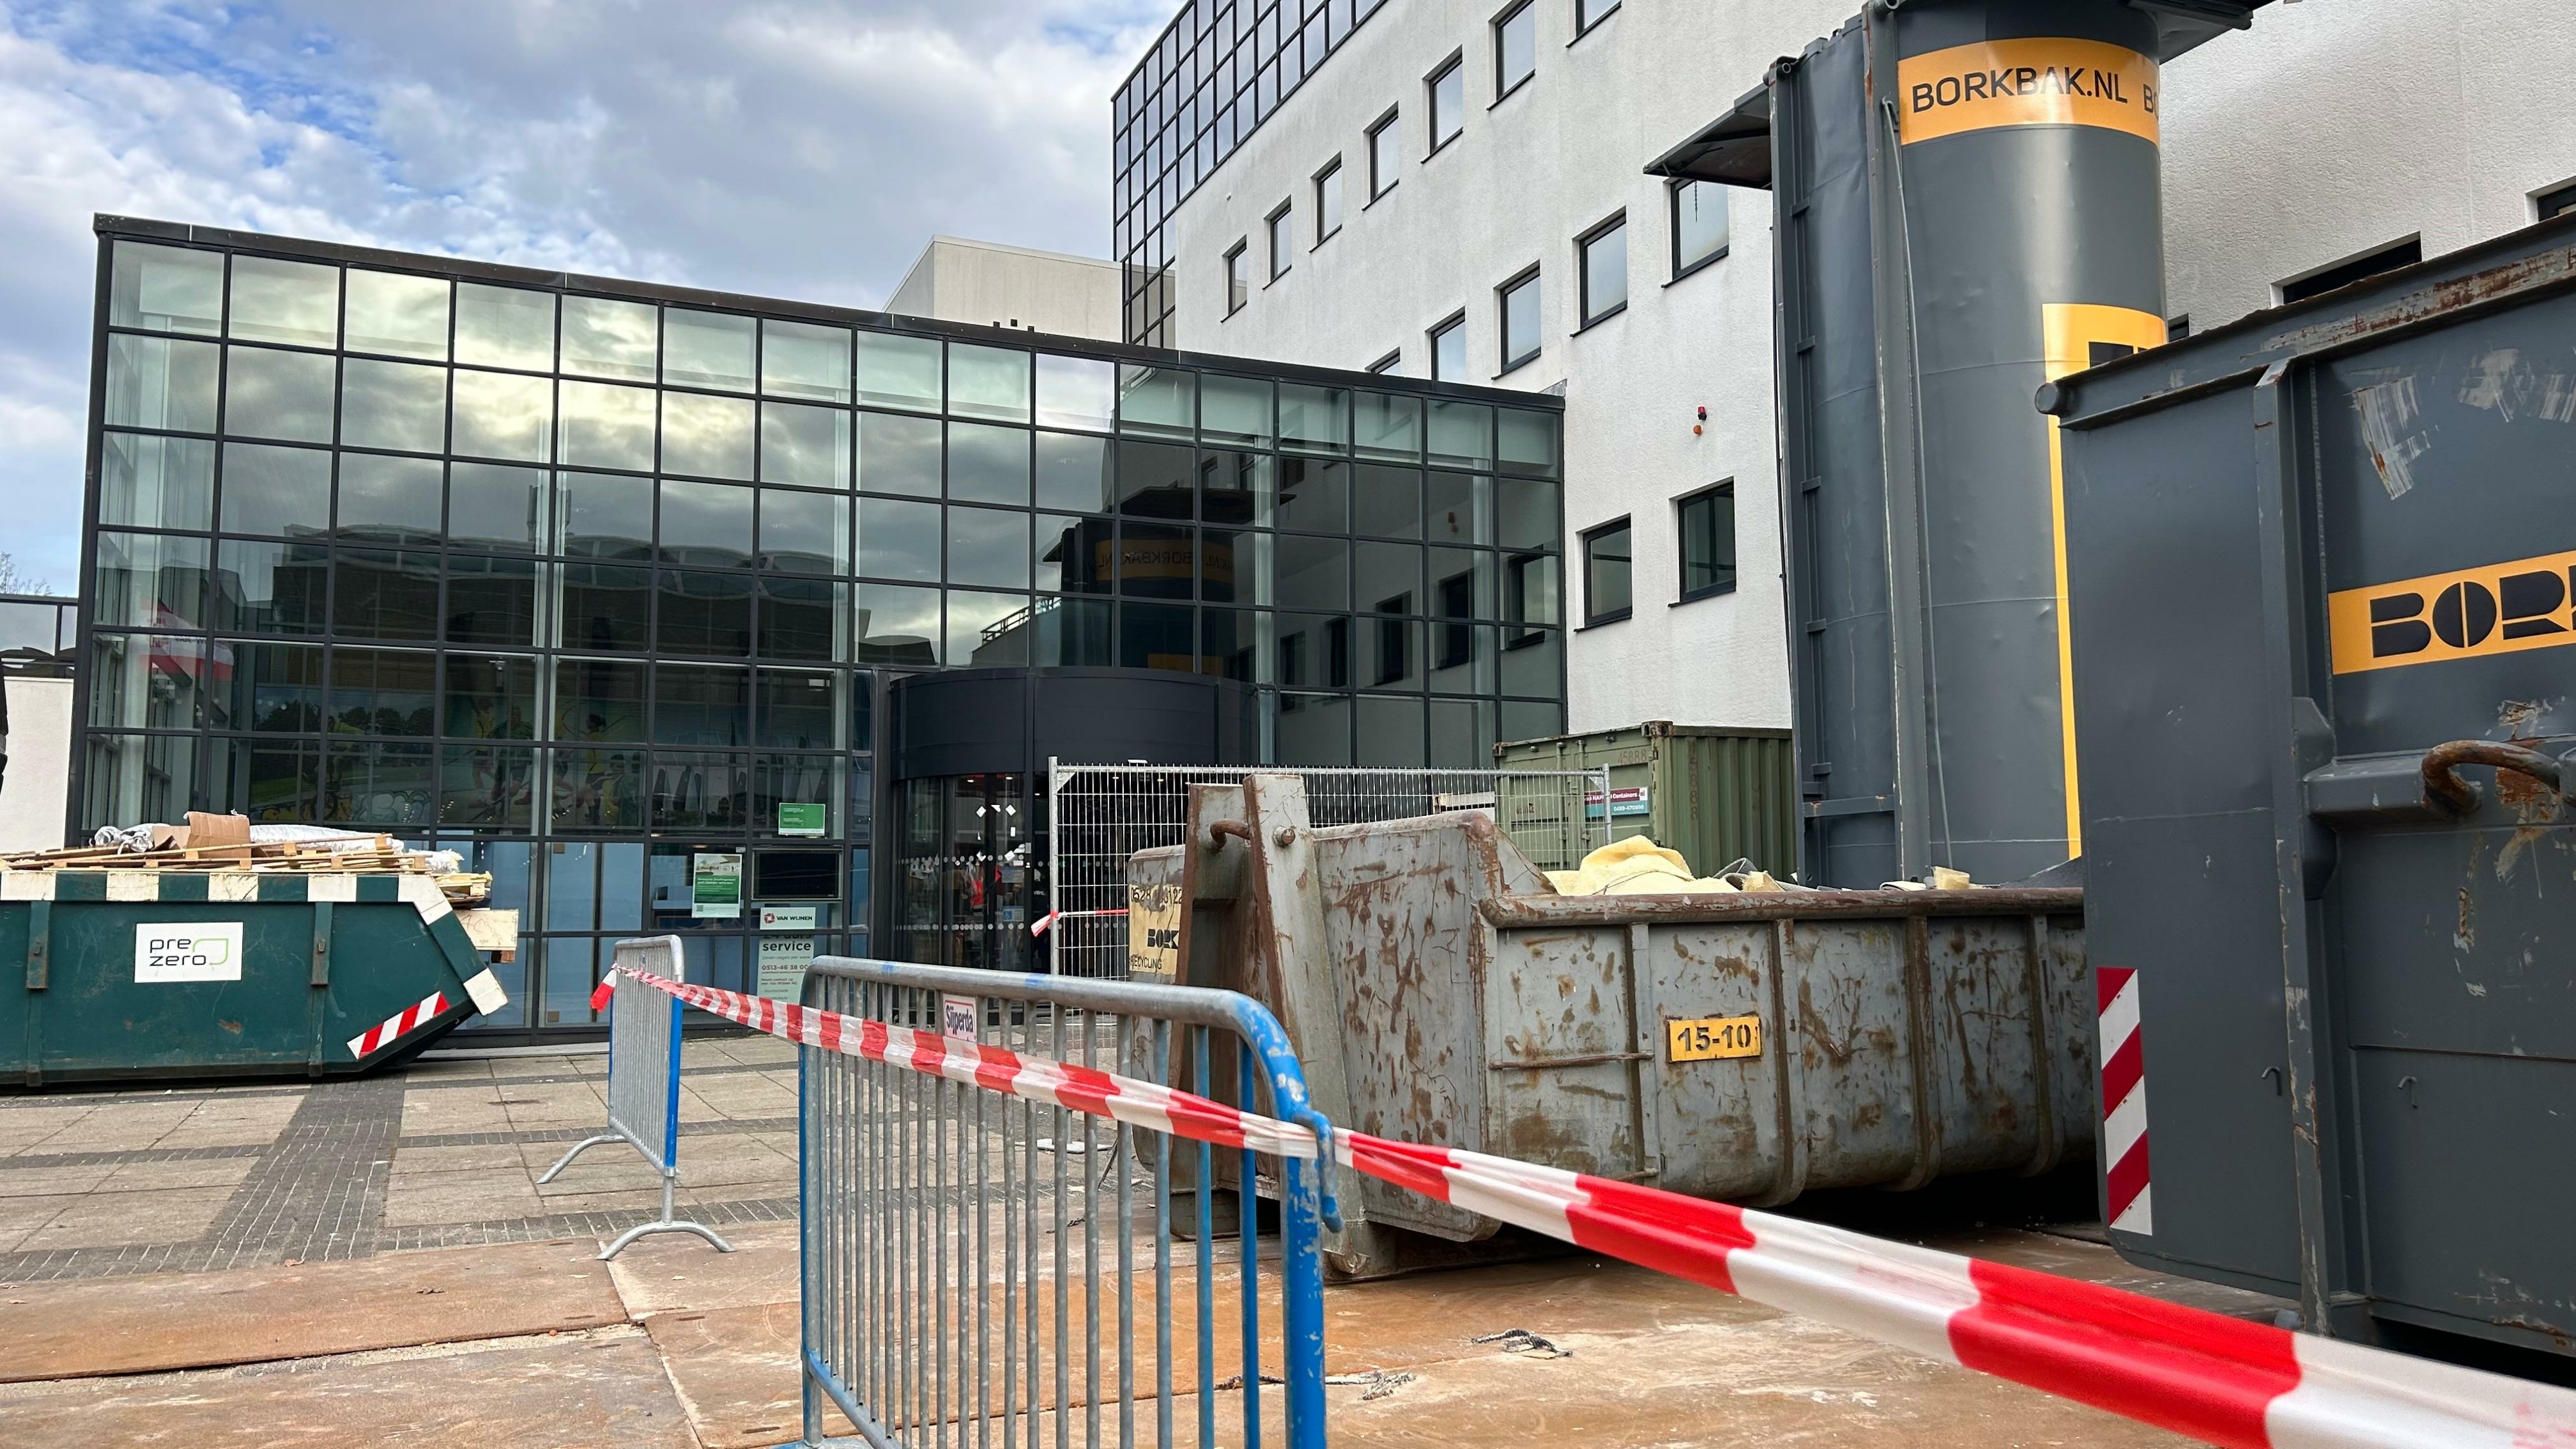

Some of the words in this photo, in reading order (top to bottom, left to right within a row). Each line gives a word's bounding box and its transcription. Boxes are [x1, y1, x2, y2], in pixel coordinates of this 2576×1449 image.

[1912, 66, 2128, 113] BORKBAK.NL
[2369, 564, 2576, 659] BOR
[150, 939, 191, 954] pre
[762, 941, 811, 951] service
[1147, 929, 1179, 949] BORK
[149, 955, 206, 966] zero
[945, 1005, 974, 1035] Sijperda
[1677, 1024, 1752, 1052] 15-10
